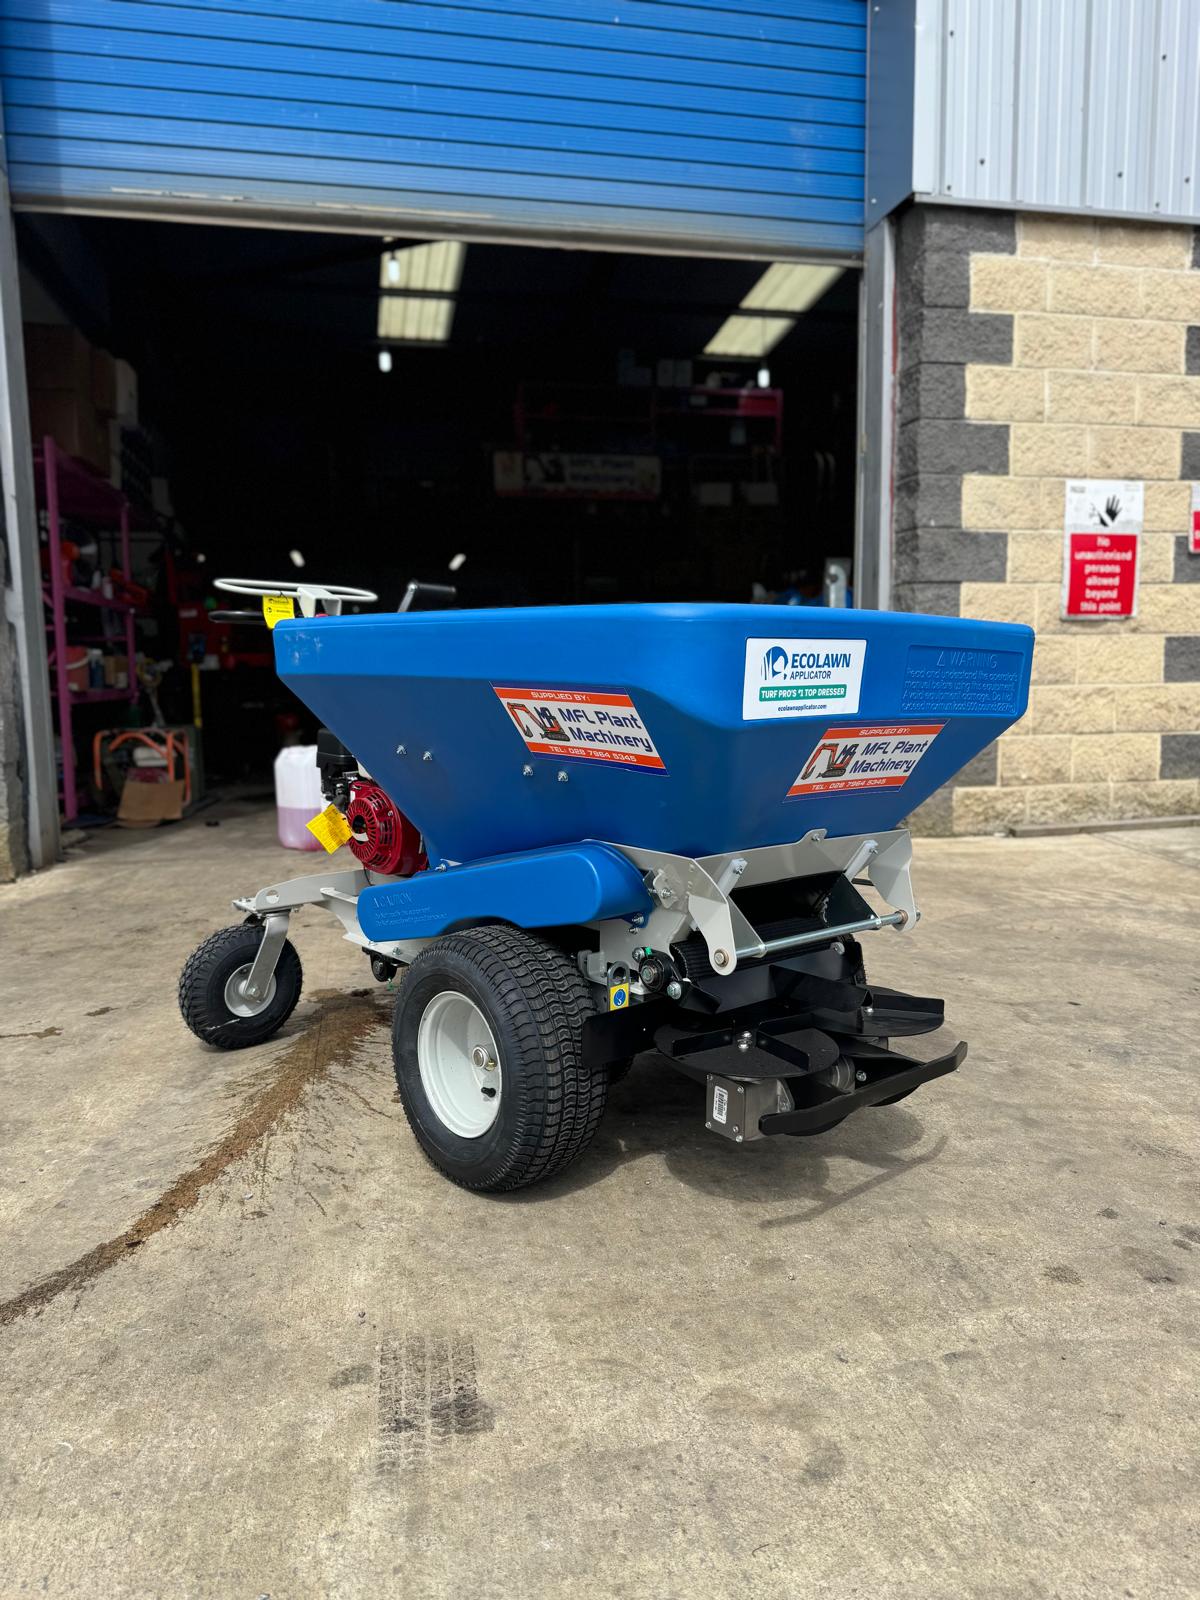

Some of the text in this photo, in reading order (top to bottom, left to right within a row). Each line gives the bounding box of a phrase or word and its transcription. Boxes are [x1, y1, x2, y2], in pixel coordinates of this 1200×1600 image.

[1096, 536, 1111, 547] No
[1084, 564, 1121, 575] persons
[1086, 575, 1120, 587] allowed
[1085, 588, 1118, 601] beyond
[1080, 601, 1122, 613] this point
[791, 653, 851, 669] ECOLAWN
[950, 651, 999, 668] WARNING
[790, 671, 832, 681] APPLICATOR
[530, 691, 591, 702] SUPPLIED BY:
[761, 690, 777, 699] TURF
[778, 689, 797, 698] PRO'S
[804, 688, 817, 697] TOP
[818, 687, 845, 696] DRESSER
[778, 704, 827, 712] ecolawnapplicator.com
[558, 708, 596, 724] MFL
[595, 710, 642, 730] Plant
[859, 727, 911, 736] SUPPLIED BY:
[568, 726, 654, 752] Machinery
[861, 742, 891, 756] MFL
[891, 740, 929, 754] Plant
[849, 758, 916, 773] Machinery
